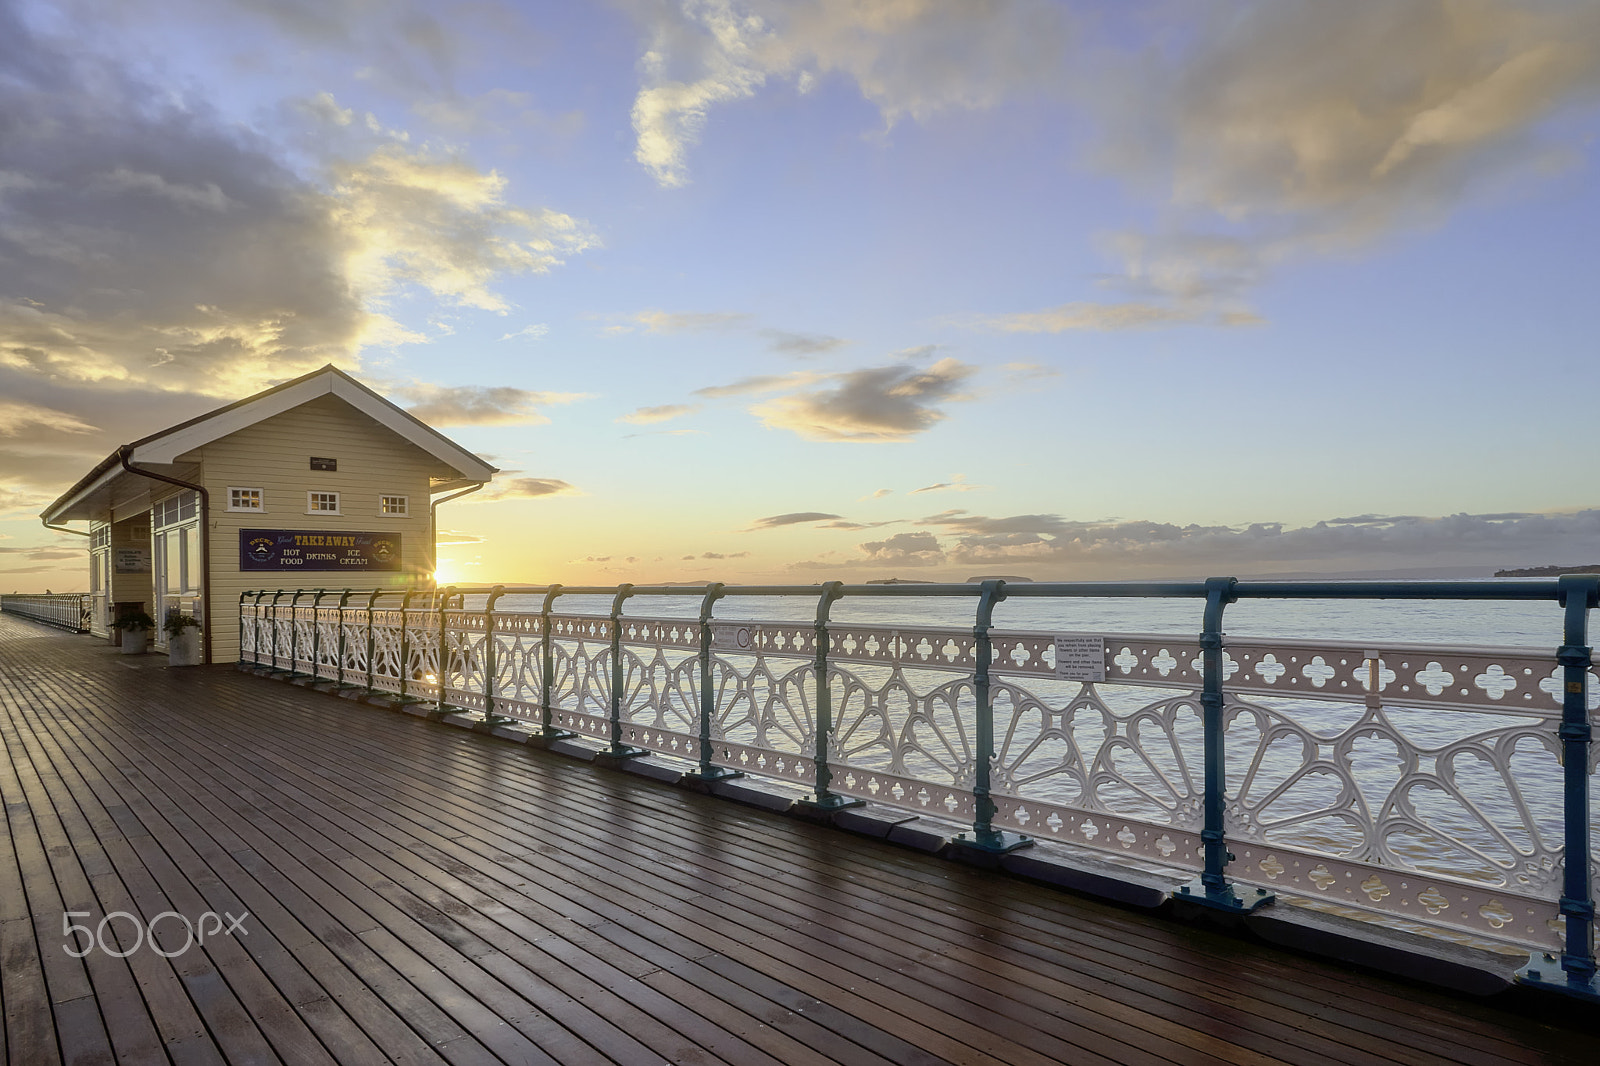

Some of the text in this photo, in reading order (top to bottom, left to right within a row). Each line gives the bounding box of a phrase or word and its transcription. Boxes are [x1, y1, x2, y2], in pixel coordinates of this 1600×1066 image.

[249, 537, 274, 546] DECKS
[295, 535, 325, 546] TAKE
[326, 536, 355, 547] AWAY
